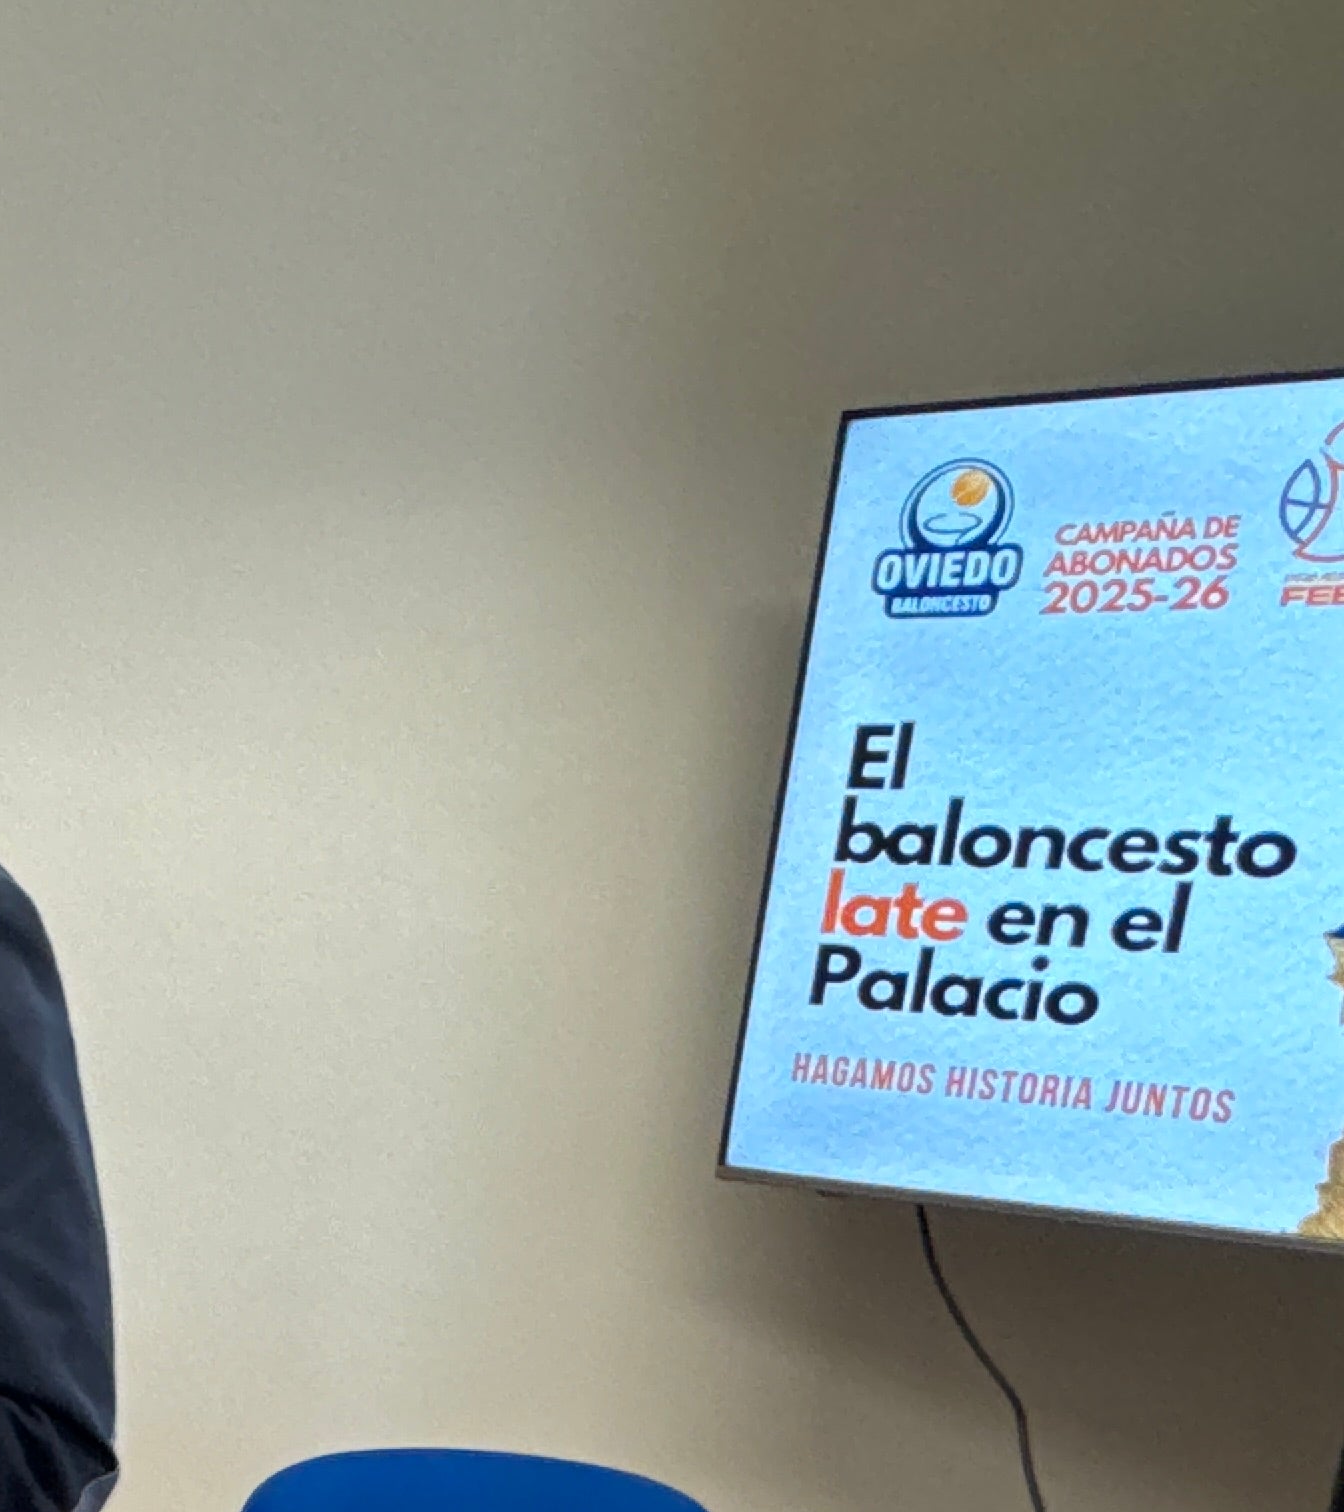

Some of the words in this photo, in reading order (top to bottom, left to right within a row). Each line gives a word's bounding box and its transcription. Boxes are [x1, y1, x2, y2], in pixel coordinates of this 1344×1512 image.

[1043, 543, 1240, 577] ABONADOS
[1055, 511, 1196, 546] CAMPAÑA
[1203, 514, 1242, 539] DE
[876, 548, 1018, 591] OVIEDO
[1039, 574, 1230, 615] 2025-26
[846, 721, 915, 790] El
[834, 795, 1298, 879] baloncesto
[820, 868, 968, 941] late
[987, 900, 1090, 948] en
[1111, 881, 1194, 953] el
[808, 944, 1100, 1026] Palacio
[791, 1052, 937, 1095] HAGAMOS
[945, 1066, 1093, 1110] HISTORIA
[1105, 1080, 1236, 1124] JUNTOS
